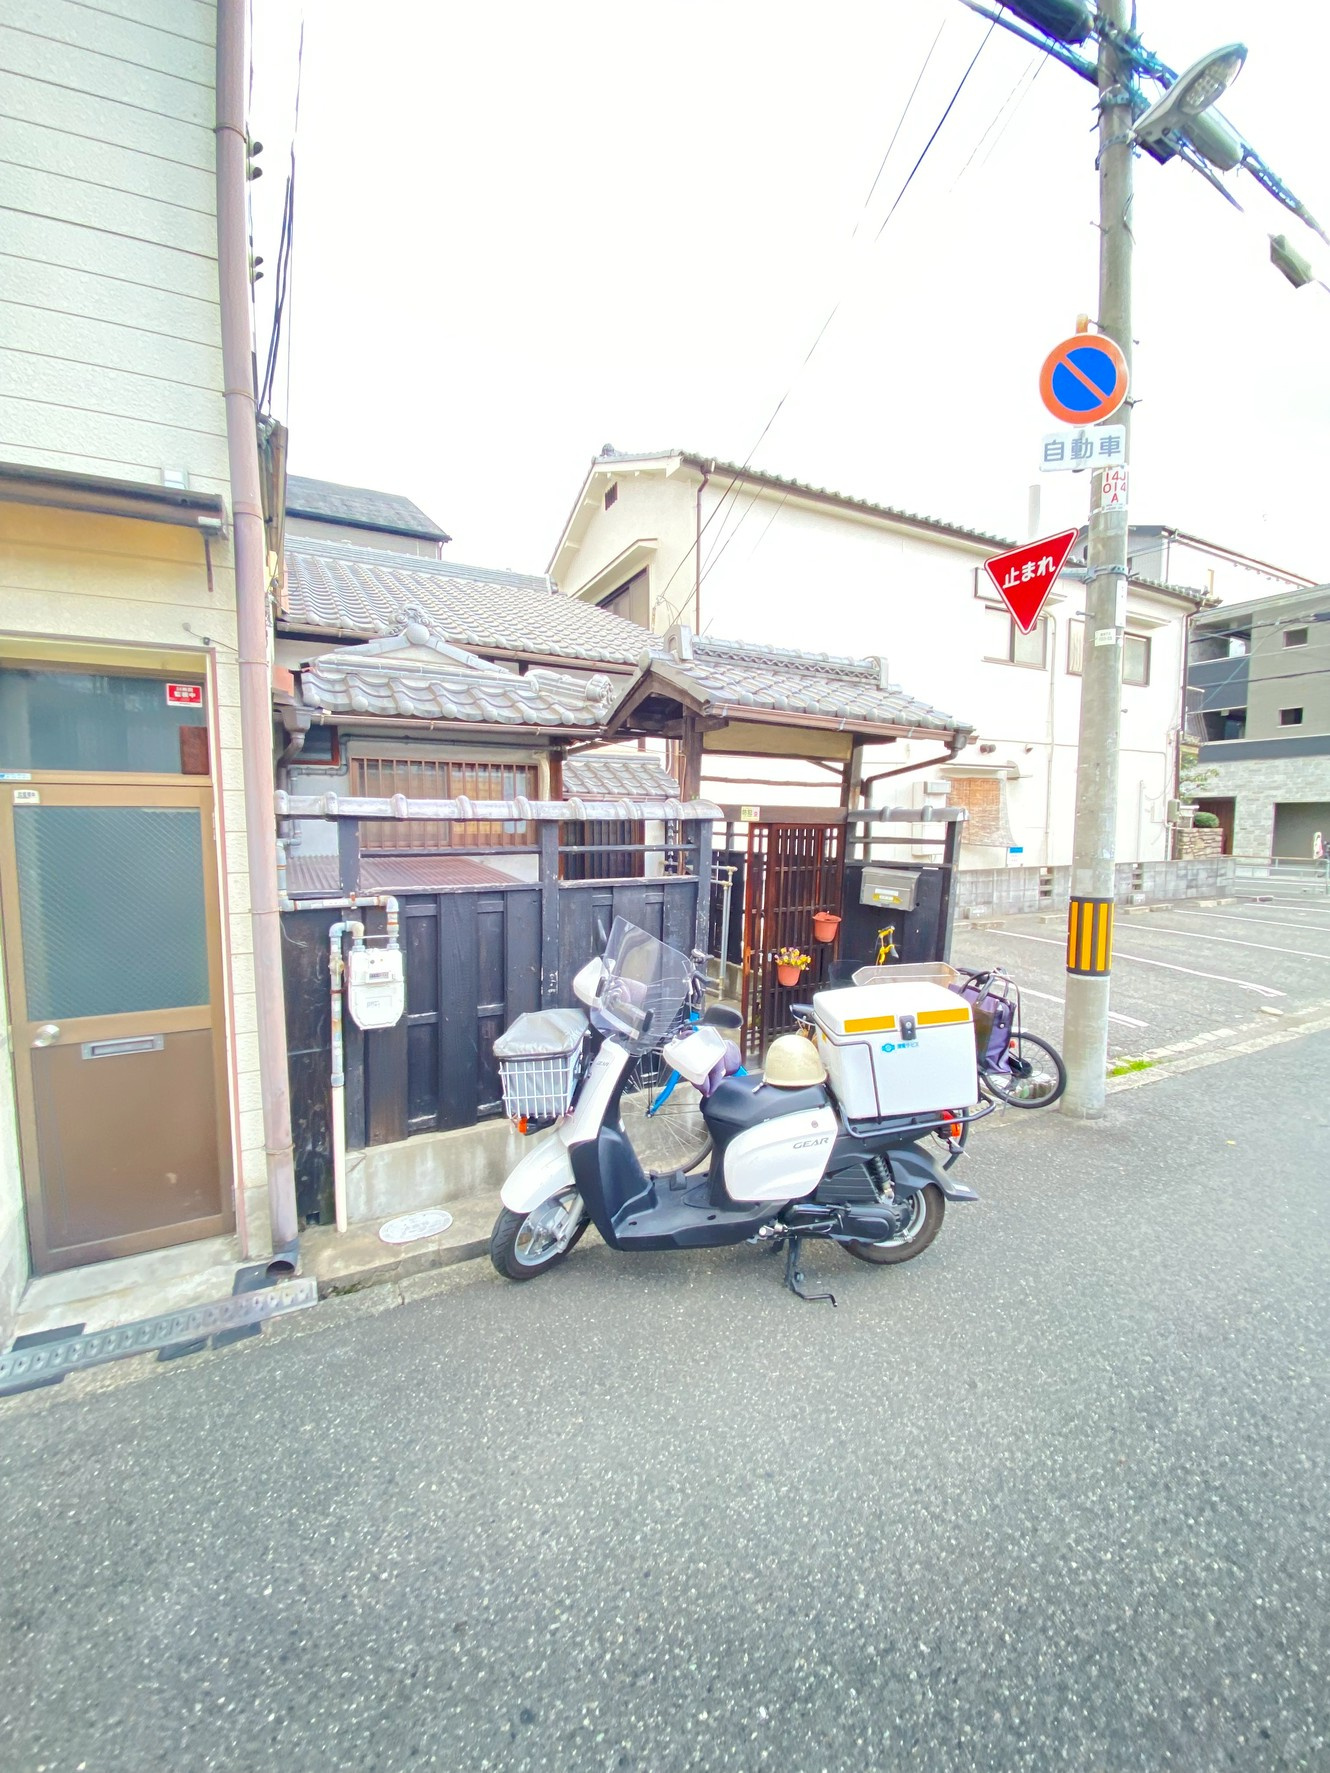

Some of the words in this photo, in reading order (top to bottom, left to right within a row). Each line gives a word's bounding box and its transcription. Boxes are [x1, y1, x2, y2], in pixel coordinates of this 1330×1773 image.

[1043, 435, 1121, 462] 自動車
[1111, 492, 1119, 503] A
[1002, 555, 1056, 588] 止まれ
[793, 1137, 829, 1149] GEAR
